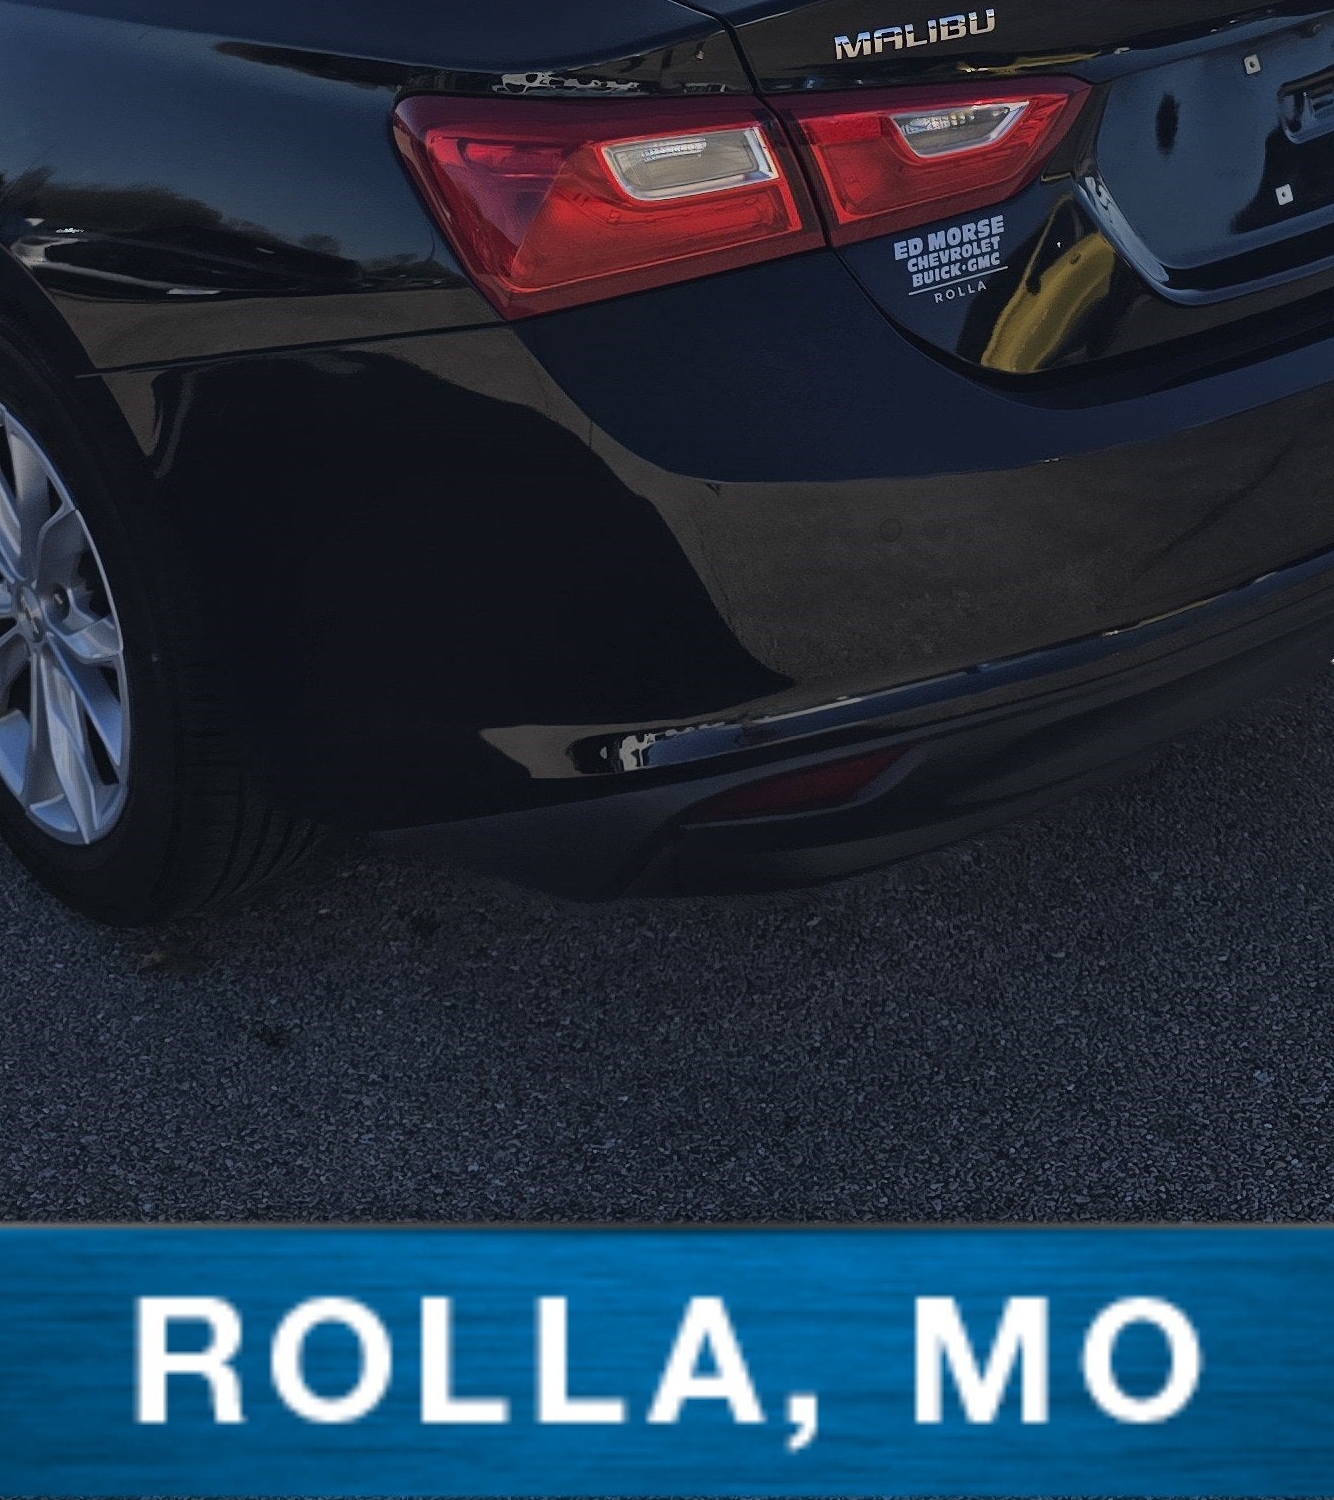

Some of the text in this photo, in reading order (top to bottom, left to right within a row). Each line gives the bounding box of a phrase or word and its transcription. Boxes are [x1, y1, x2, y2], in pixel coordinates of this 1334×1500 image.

[834, 8, 996, 60] MALIBU
[893, 215, 1005, 260] ED MORSE
[907, 236, 1000, 273] CHEVROLET
[933, 280, 987, 304] ROLLA
